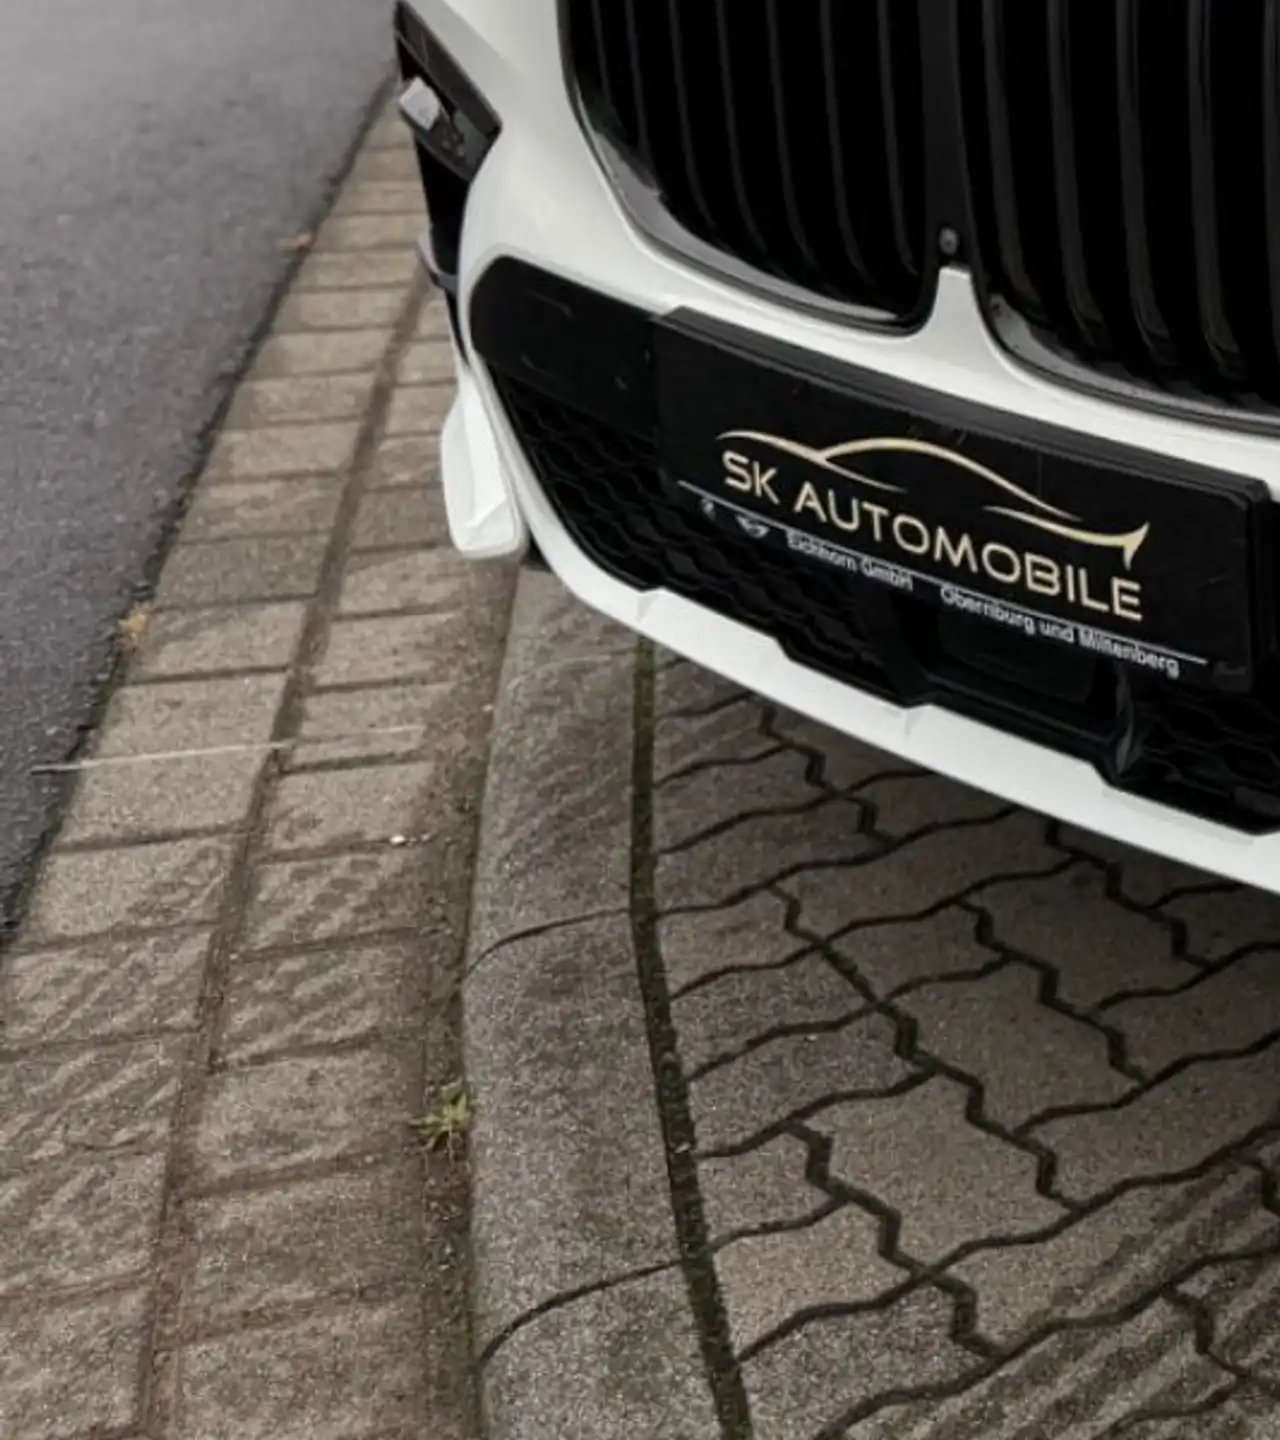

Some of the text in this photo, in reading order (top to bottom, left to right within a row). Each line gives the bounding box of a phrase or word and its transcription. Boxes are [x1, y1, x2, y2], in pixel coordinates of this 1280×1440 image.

[722, 449, 1143, 622] SK AUTOMOBILE
[860, 557, 914, 592] GmbH
[939, 582, 1036, 635] Obernburg
[1039, 617, 1075, 644] und
